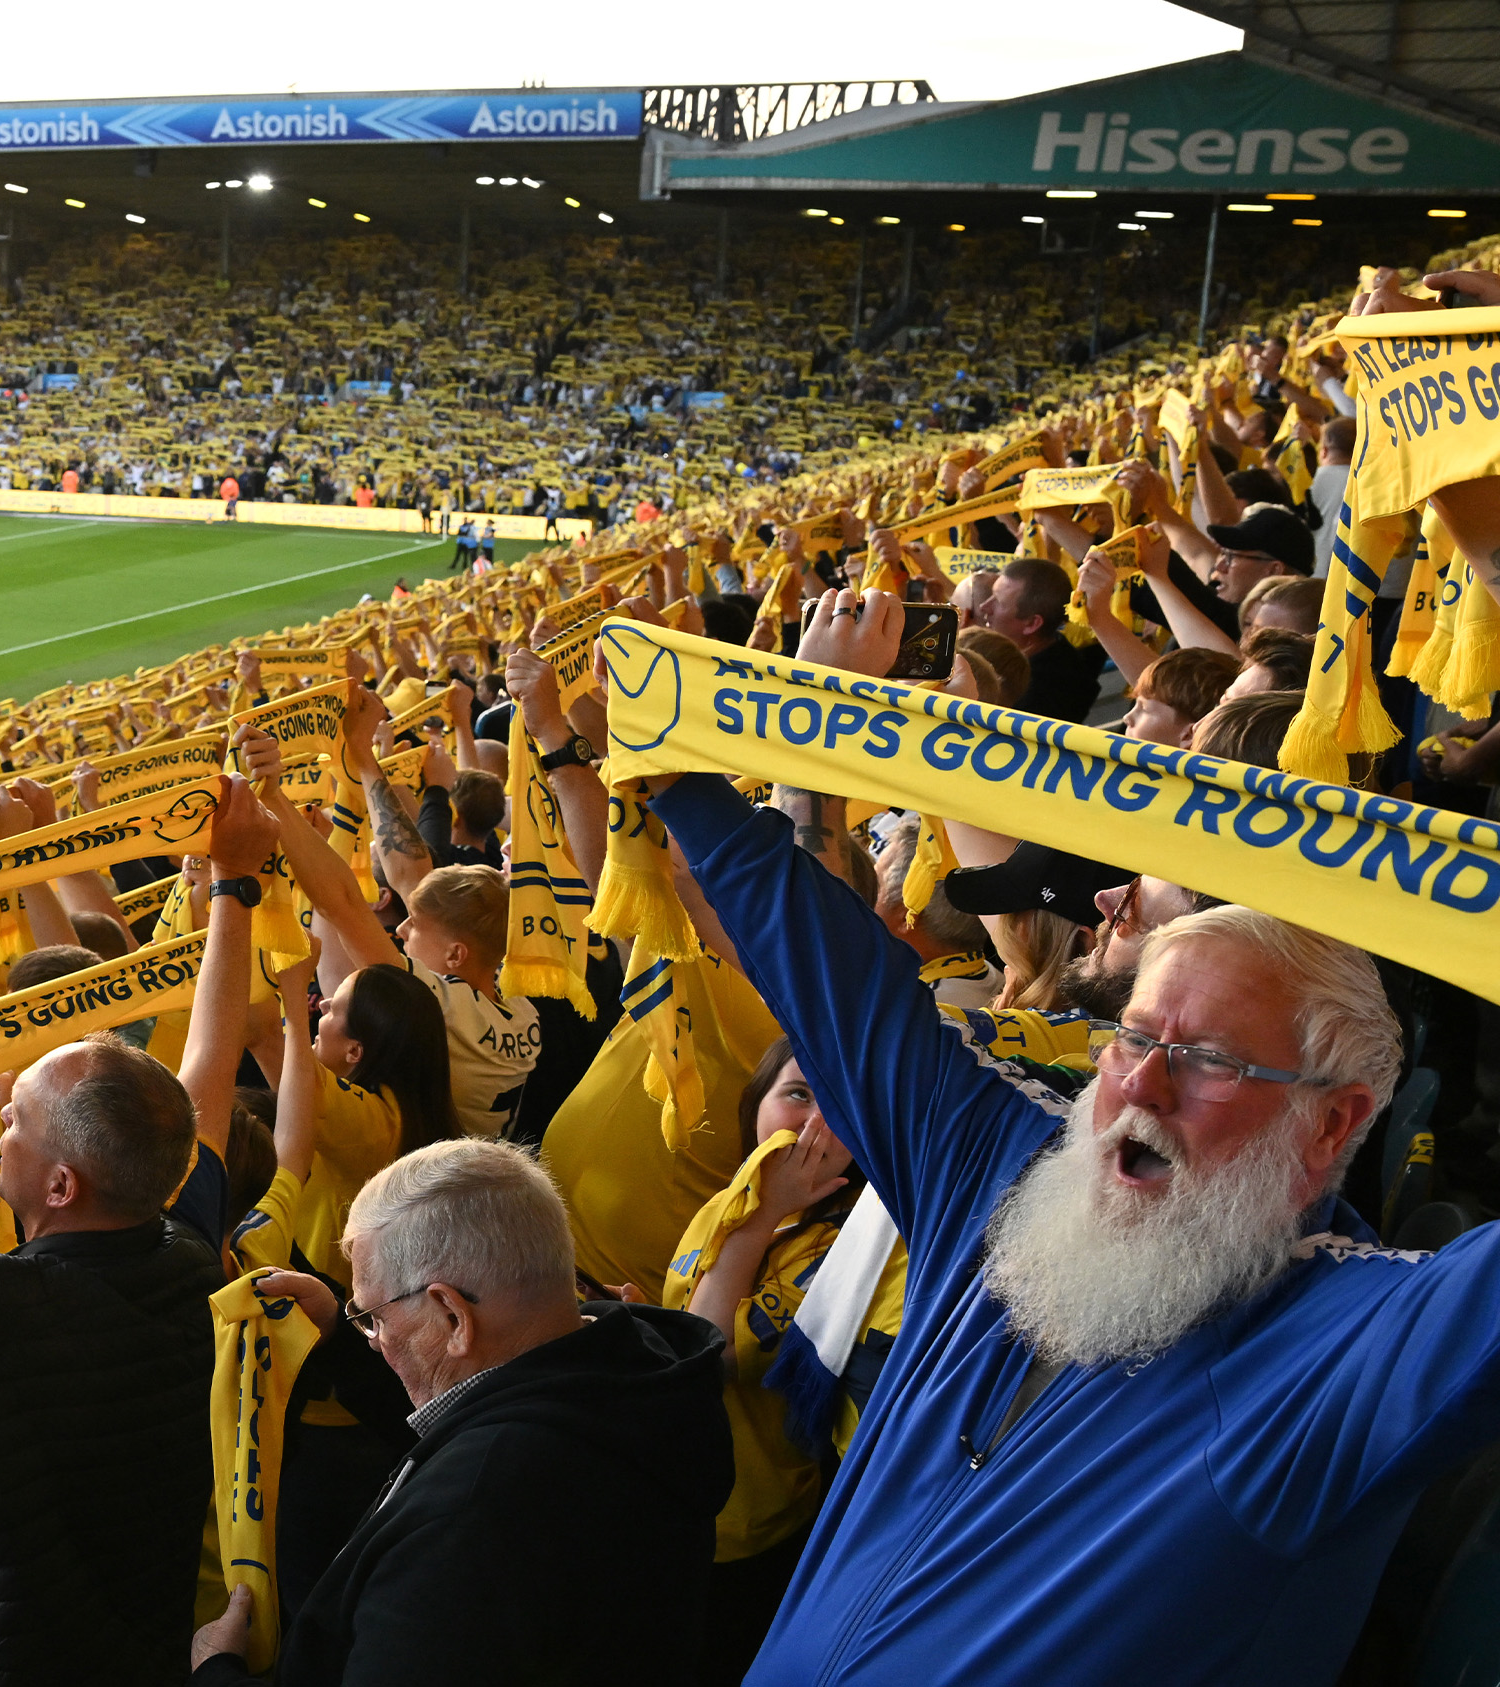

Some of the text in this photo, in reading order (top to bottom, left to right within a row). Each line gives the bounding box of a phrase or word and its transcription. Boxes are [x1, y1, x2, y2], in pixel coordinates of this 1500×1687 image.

[211, 107, 347, 140] Astonish
[469, 101, 617, 135] Astonish
[1032, 112, 1409, 175] Hisense
[1353, 342, 1384, 389] AT
[1380, 371, 1466, 448] STOPS
[278, 713, 315, 742] GOING
[317, 713, 338, 740] ROU
[134, 751, 179, 772] GOING
[714, 688, 1500, 913] STOPS GOING ROUND
[27, 977, 133, 1026] GOING
